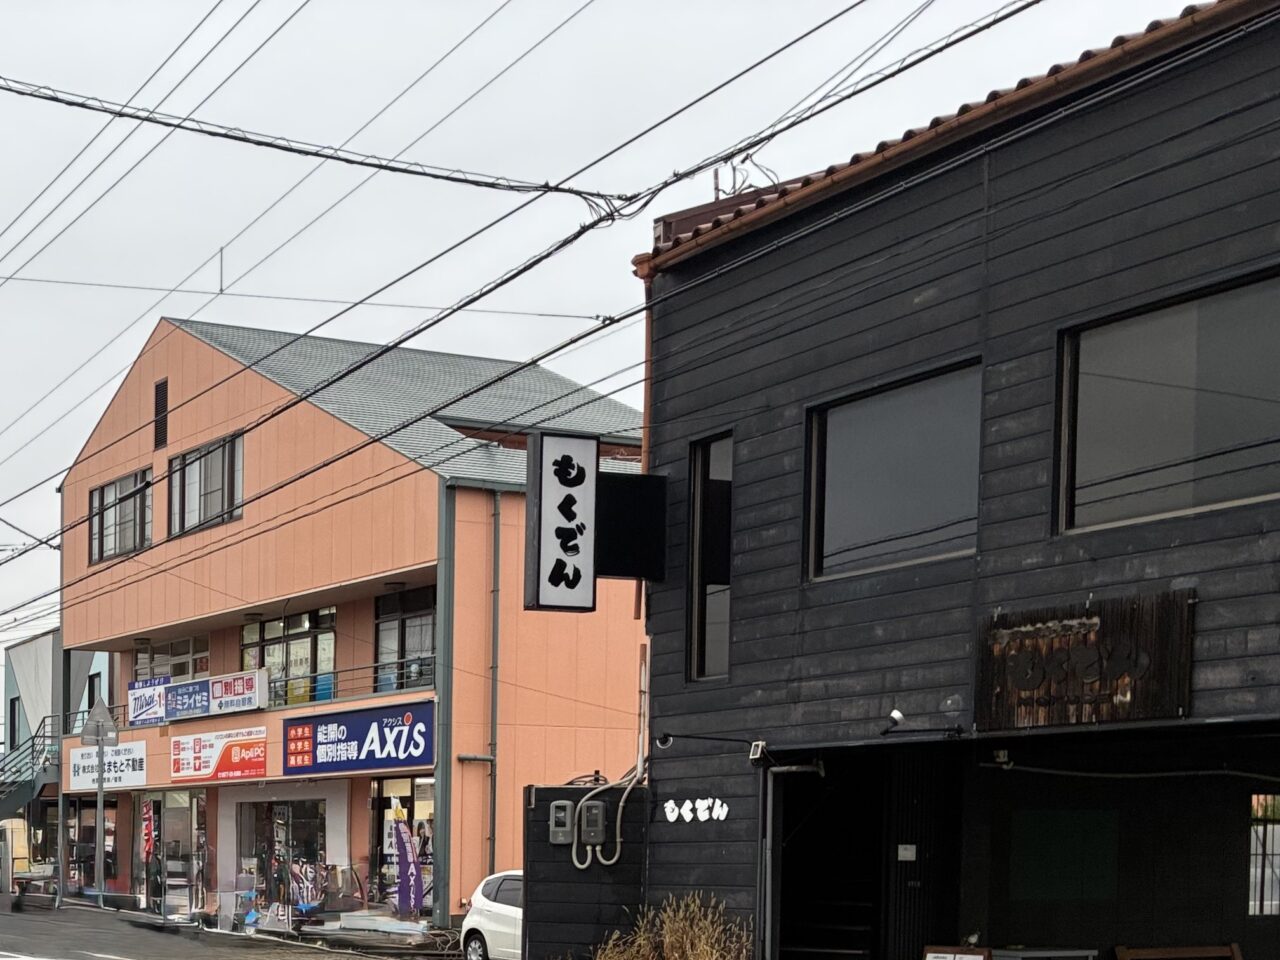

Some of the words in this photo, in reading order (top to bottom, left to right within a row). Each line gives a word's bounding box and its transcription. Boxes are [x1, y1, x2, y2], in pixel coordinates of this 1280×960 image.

[548, 454, 586, 590] もくでん
[382, 716, 403, 727] アクシス
[289, 727, 310, 738] 小学生
[317, 723, 347, 743] 能開の
[289, 740, 310, 751] 中学生
[317, 741, 358, 763] 個別指導
[663, 796, 729, 823] もくでん
